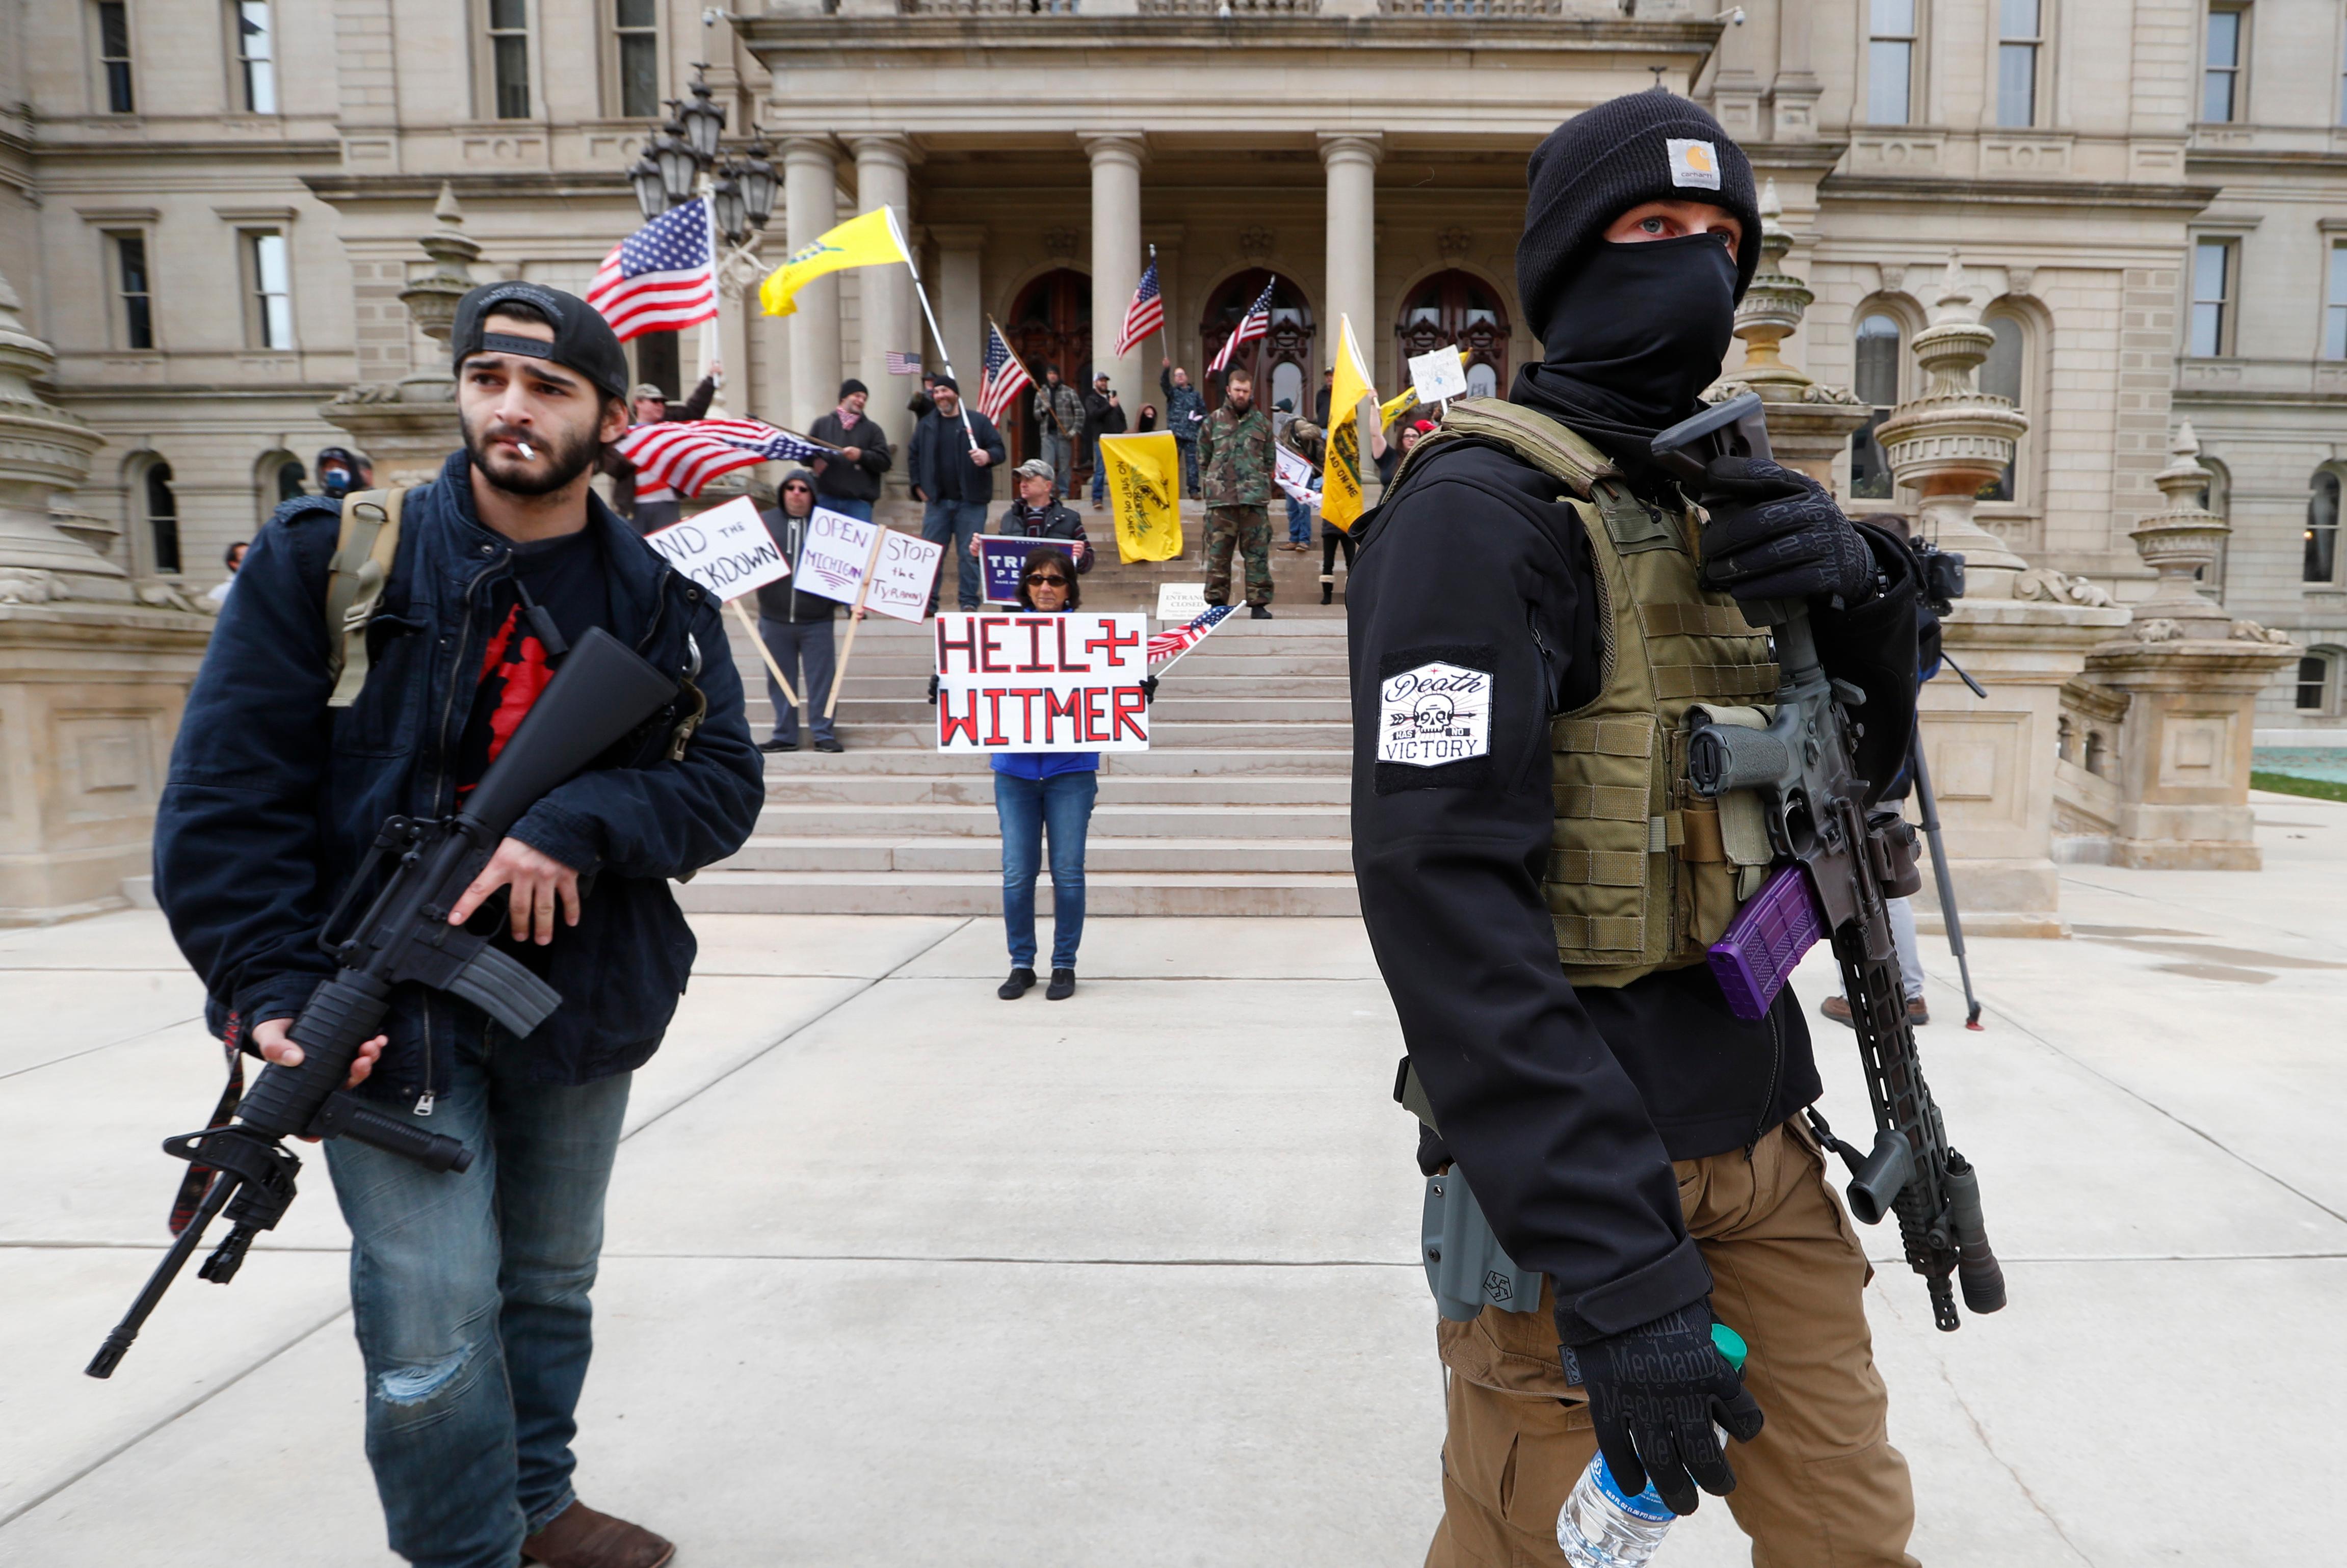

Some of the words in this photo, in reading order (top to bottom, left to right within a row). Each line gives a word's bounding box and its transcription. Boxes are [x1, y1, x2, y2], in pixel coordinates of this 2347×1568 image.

[1116, 461, 1126, 475] NO
[1328, 447, 1339, 469] EAD
[1337, 469, 1349, 483] ON
[1346, 483, 1358, 498] ME
[1121, 477, 1132, 498] STEP
[1124, 501, 1132, 513] ON
[655, 526, 707, 560] ND
[718, 521, 746, 537] THE
[815, 515, 868, 548] OPEN
[805, 549, 862, 578] MICHIGAN
[887, 538, 935, 563] STOP
[691, 541, 779, 591] CKDOWN
[892, 567, 915, 580] the
[936, 617, 1091, 674] HEIL
[1385, 672, 1486, 702] Death
[940, 685, 1147, 746] WITMER
[1386, 739, 1478, 759] VICTORY
[1605, 1489, 1615, 1500] 16.9
[1627, 1507, 1640, 1516] (1.06
